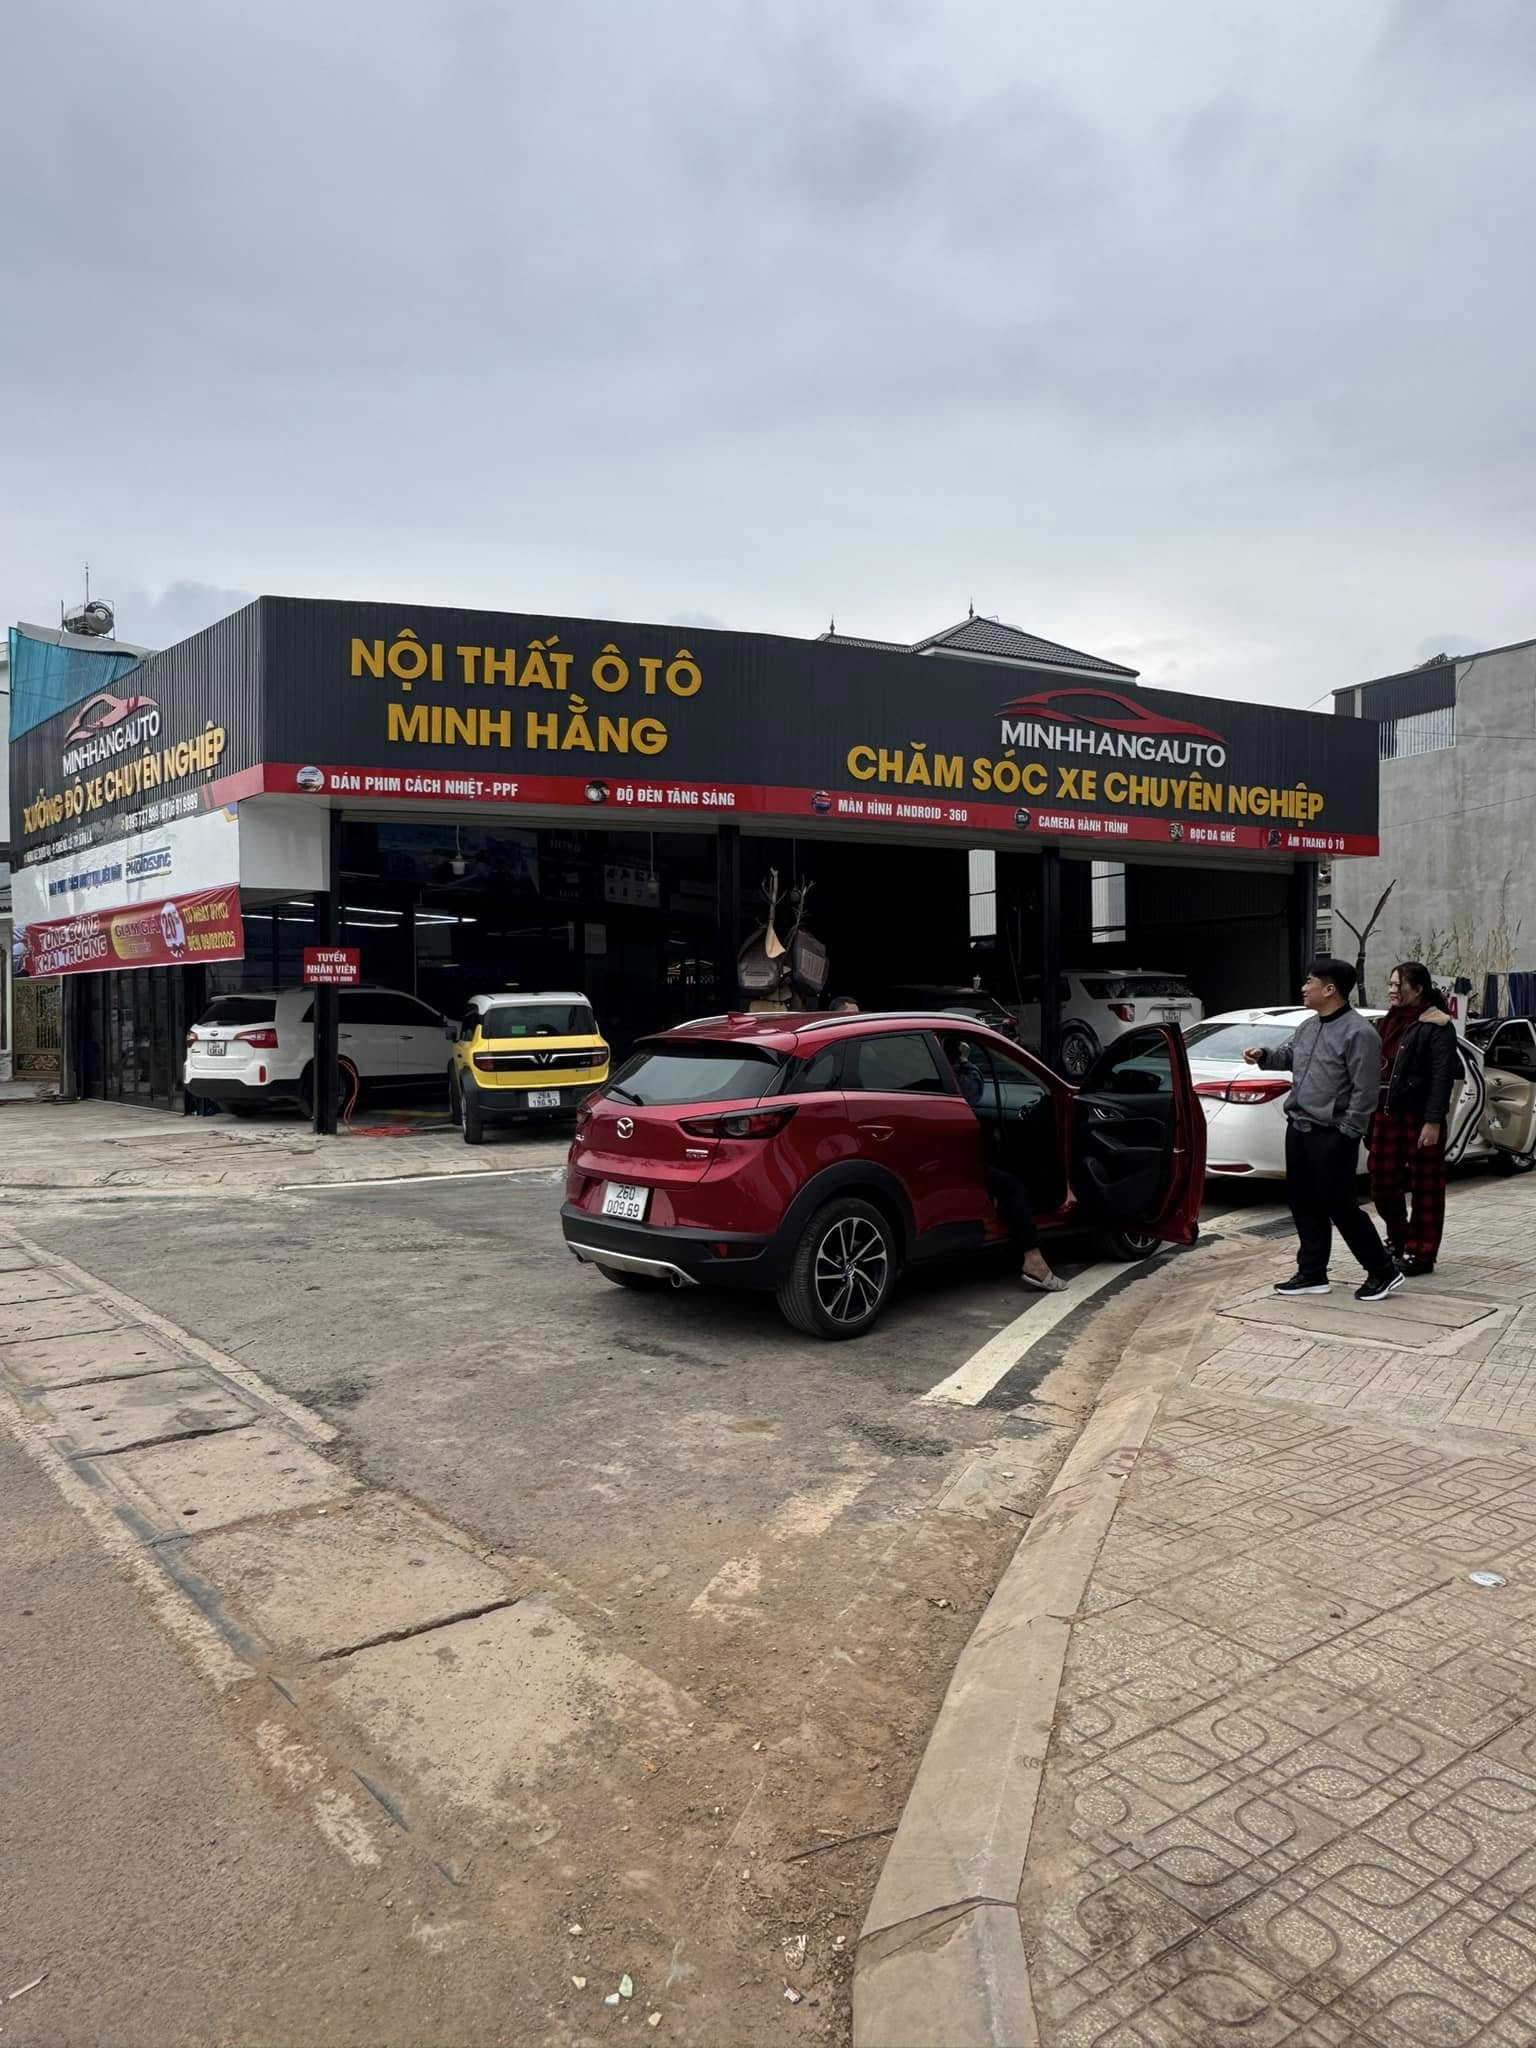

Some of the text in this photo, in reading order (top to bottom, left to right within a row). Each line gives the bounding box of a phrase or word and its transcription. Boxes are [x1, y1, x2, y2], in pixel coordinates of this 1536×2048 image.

[351, 628, 702, 697] NỘI THẤT Ô TÔ
[388, 693, 668, 755] MINH HẰNG
[62, 711, 160, 777] MINHHANGAUTO
[1001, 720, 1226, 767] MINHHANGAUTO
[23, 720, 225, 834] XƯỞNG ĐỘ XE CHUYÊN NGHIỆP
[331, 772, 361, 790] DÁN
[365, 776, 401, 791] PHIM
[405, 776, 441, 793] CÁCH
[847, 742, 1325, 827] CHĂM SÓC XE CHUYÊN NGHIỆP
[616, 785, 735, 806] ĐỘ ĐÈN TĂNG SÁNG
[838, 797, 863, 813] MÀN
[867, 799, 893, 816] HÌNH
[1038, 816, 1128, 834] CAMERA HÀNH TRÌNH
[1190, 828, 1236, 843] BỌC DA GHẾ
[1302, 837, 1326, 849] THANH
[306, 963, 357, 975] NHÂN VIÊN
[606, 1199, 640, 1218] 009.69
